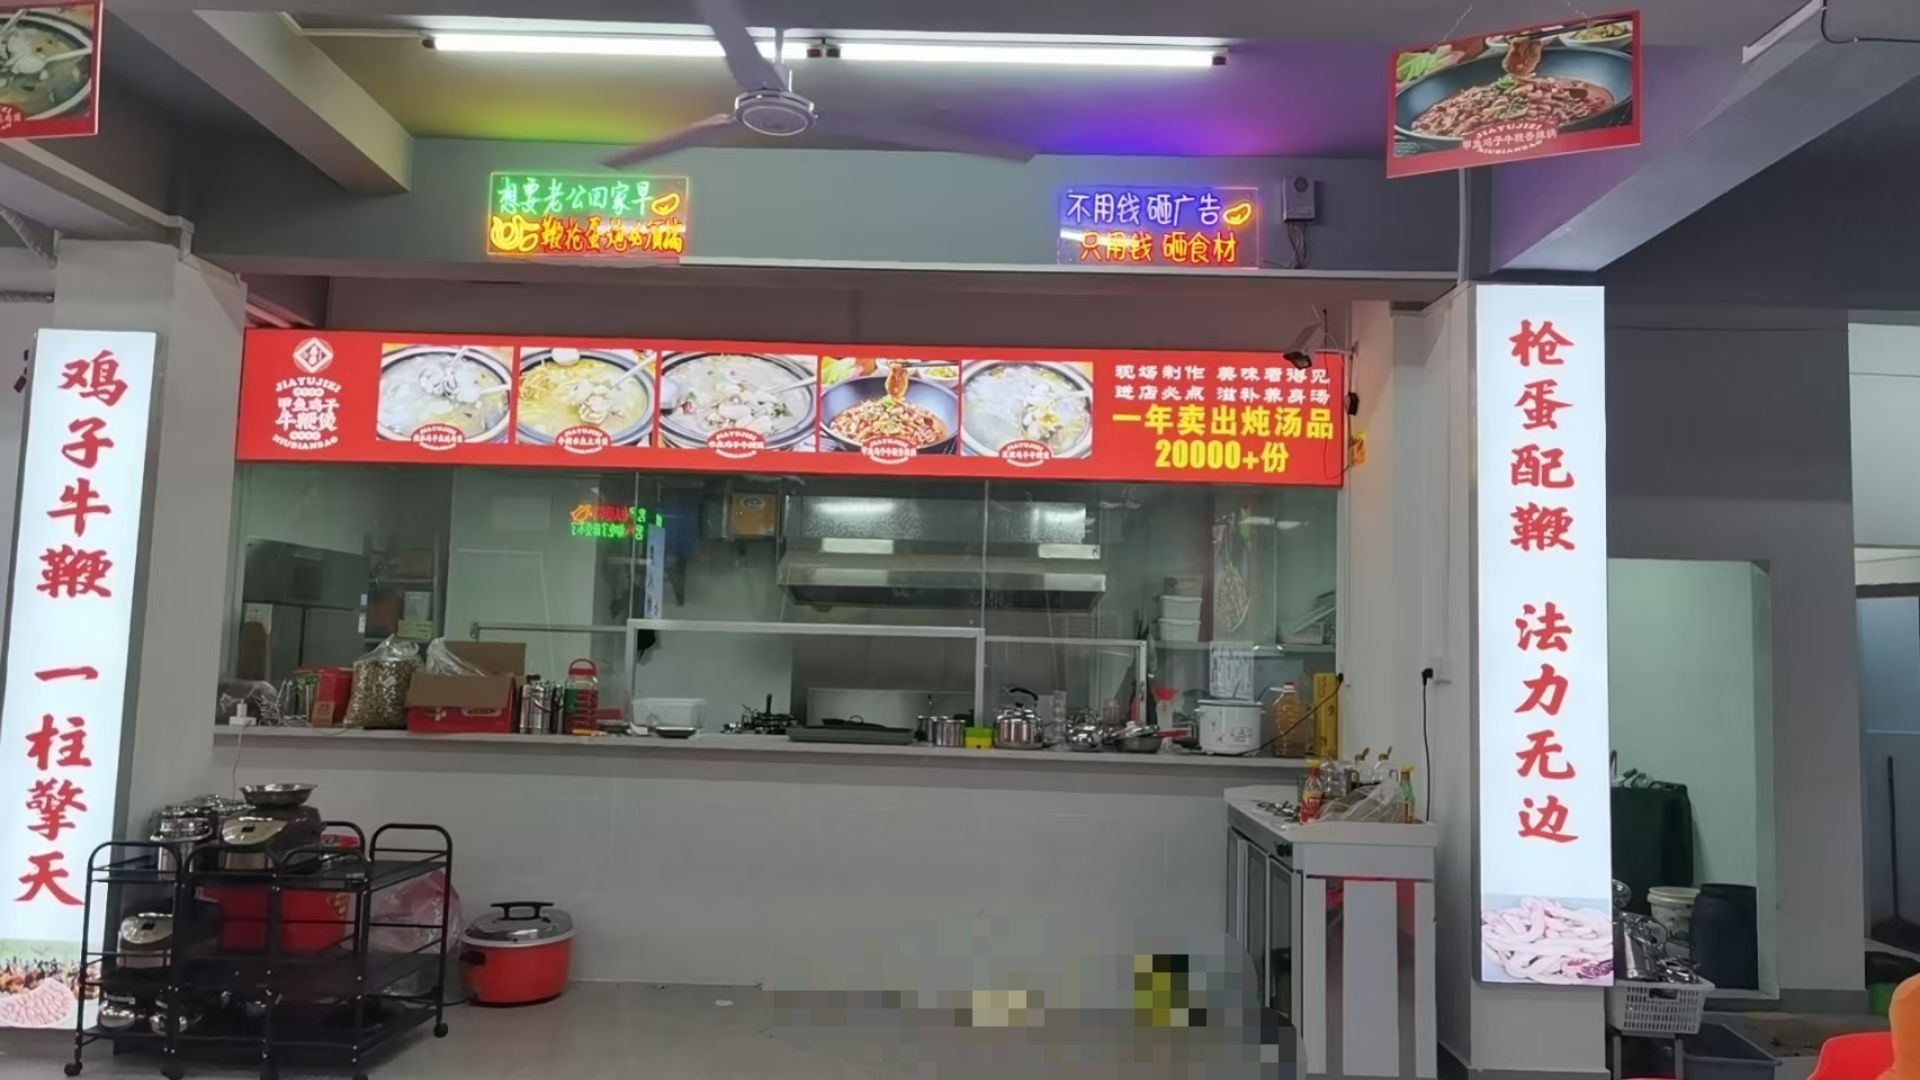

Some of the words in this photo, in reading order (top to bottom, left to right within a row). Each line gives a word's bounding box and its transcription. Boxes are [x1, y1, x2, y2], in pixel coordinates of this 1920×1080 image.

[1476, 123, 1542, 138] JIAYUJIZI
[498, 177, 653, 215] 想要老公回家早
[1067, 193, 1140, 224] 不用钱
[1147, 193, 1221, 226] 砸广告
[1081, 231, 1153, 261] 只用钱
[1163, 231, 1237, 263] 砸食材
[275, 377, 342, 393] JIAYUJIZI
[1115, 365, 1205, 380] 现场制作
[1217, 366, 1330, 384] 美味看得见
[1115, 385, 1205, 401] 进店必点
[1217, 387, 1330, 405] 滋补养身汤
[1112, 403, 1334, 439] 一年卖出炖汤品
[1509, 319, 1575, 551] 枪蛋配鞭
[272, 434, 338, 449] NIUBIANBAO
[1155, 439, 1289, 473] 20000+份
[36, 350, 128, 598] 鸡子牛鞭
[1514, 602, 1579, 842] 法力无边
[14, 666, 98, 906] 一柱擎天
